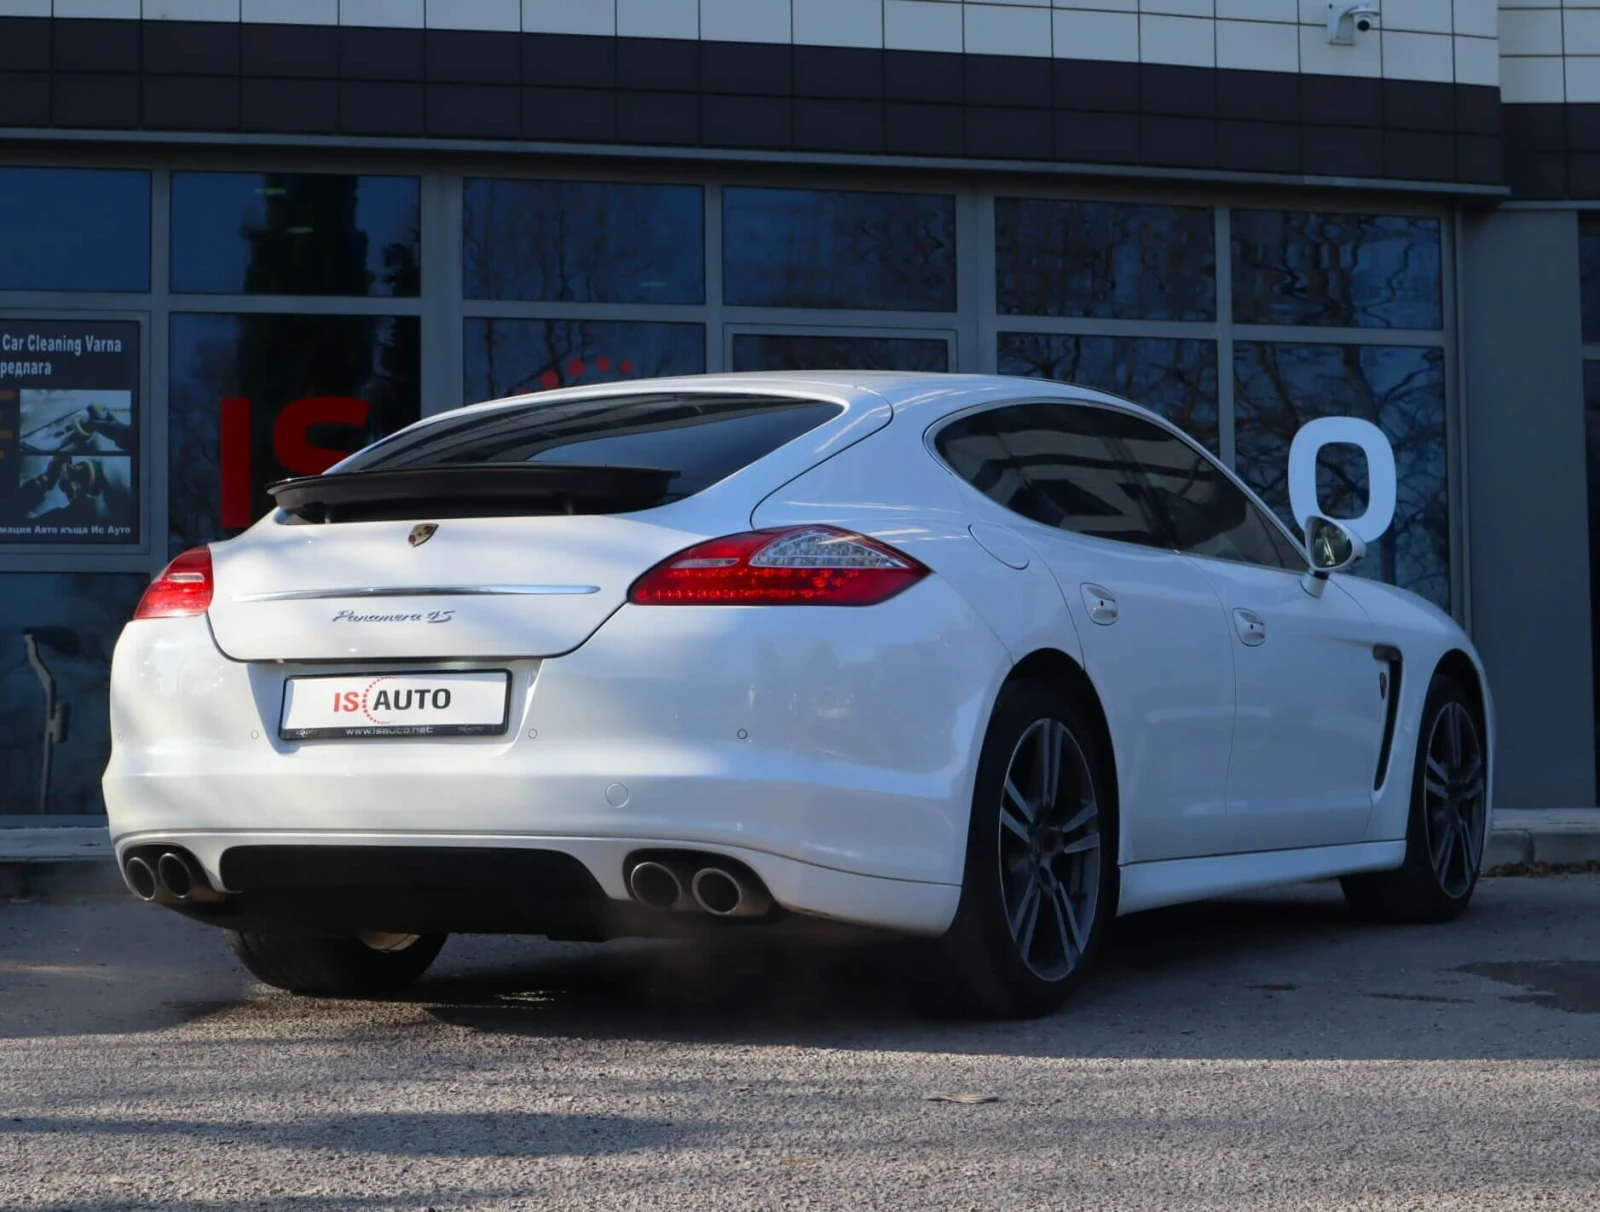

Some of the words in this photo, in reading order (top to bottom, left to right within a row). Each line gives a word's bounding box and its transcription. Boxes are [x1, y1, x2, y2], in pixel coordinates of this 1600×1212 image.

[2, 333, 25, 351] Car
[27, 334, 82, 356] Cleaning
[85, 335, 123, 352] Varna
[34, 525, 58, 534] Авто
[60, 526, 89, 536] къща
[91, 525, 105, 534] Ис
[107, 525, 131, 536] Ауто
[331, 609, 422, 623] Panamera
[425, 609, 456, 624] 4S
[333, 691, 360, 712] IS
[372, 688, 452, 711] AUTO
